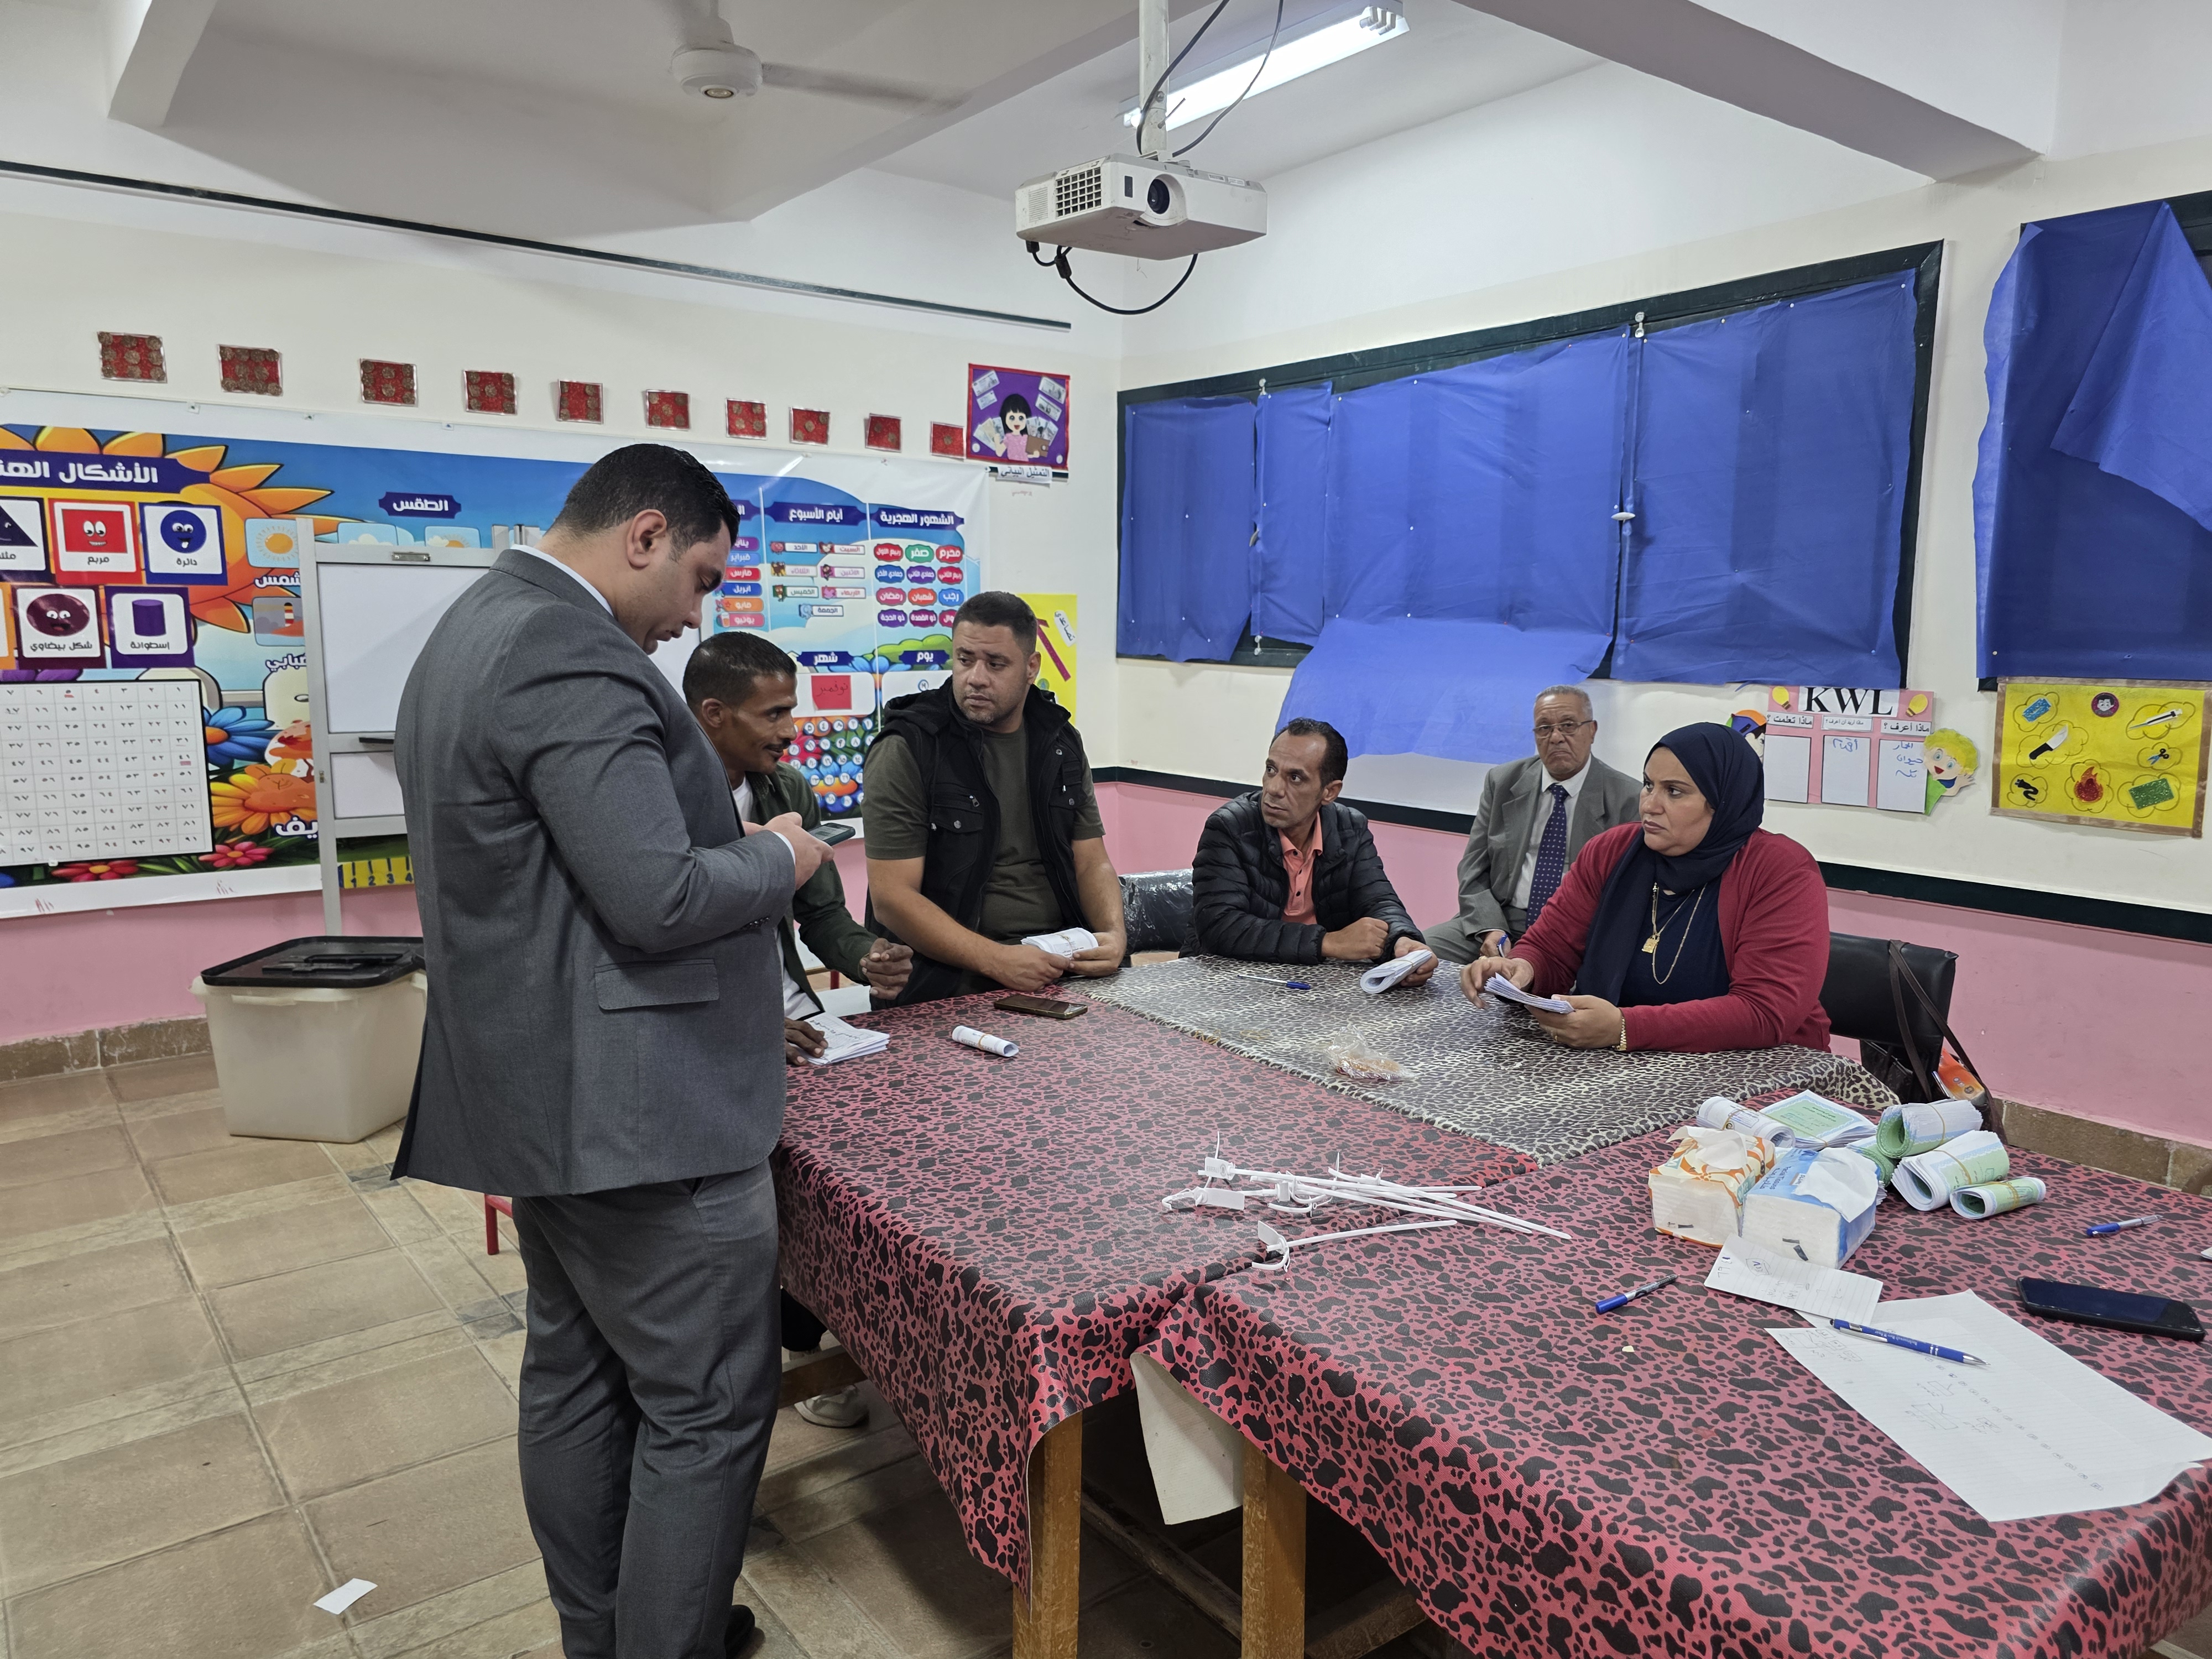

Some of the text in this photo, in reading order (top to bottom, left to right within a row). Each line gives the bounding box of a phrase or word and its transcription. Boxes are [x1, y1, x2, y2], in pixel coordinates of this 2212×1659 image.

[59, 461, 158, 483] الأشكال
[1026, 467, 1050, 479] التمثيل
[393, 498, 448, 511] الطقس
[789, 507, 824, 521] الأسبوع
[880, 511, 954, 526] الشهور الهجرية
[731, 554, 750, 562] فبراير
[889, 549, 901, 557] ربيع
[911, 548, 930, 559] صفر
[940, 549, 961, 559] محرم
[87, 556, 109, 565] مربع
[176, 557, 197, 566] دائرة
[730, 570, 752, 578] مارس
[880, 592, 903, 601] رمضان
[911, 592, 933, 602] شعبان
[943, 592, 959, 602] رجب
[735, 601, 752, 609] مايو
[734, 616, 754, 625] يونيو
[880, 613, 905, 623] ذو الحجة
[929, 614, 936, 623] ذو
[30, 641, 93, 652] شكل بيضاوي
[813, 651, 838, 665] شهر
[916, 652, 934, 662] يوم
[816, 681, 848, 697] نوفمبر
[1803, 687, 1893, 716] KWL
[1773, 716, 1796, 724] تعلمت
[1799, 716, 1812, 725] ماذا
[1916, 723, 1929, 732] ماذا
[1896, 754, 1923, 765] حيوان
[275, 816, 319, 839] يف
[351, 872, 413, 888] 1 2 3 4
[1779, 1166, 1792, 1176] Facial
[1769, 1176, 1785, 1190] Tissues
